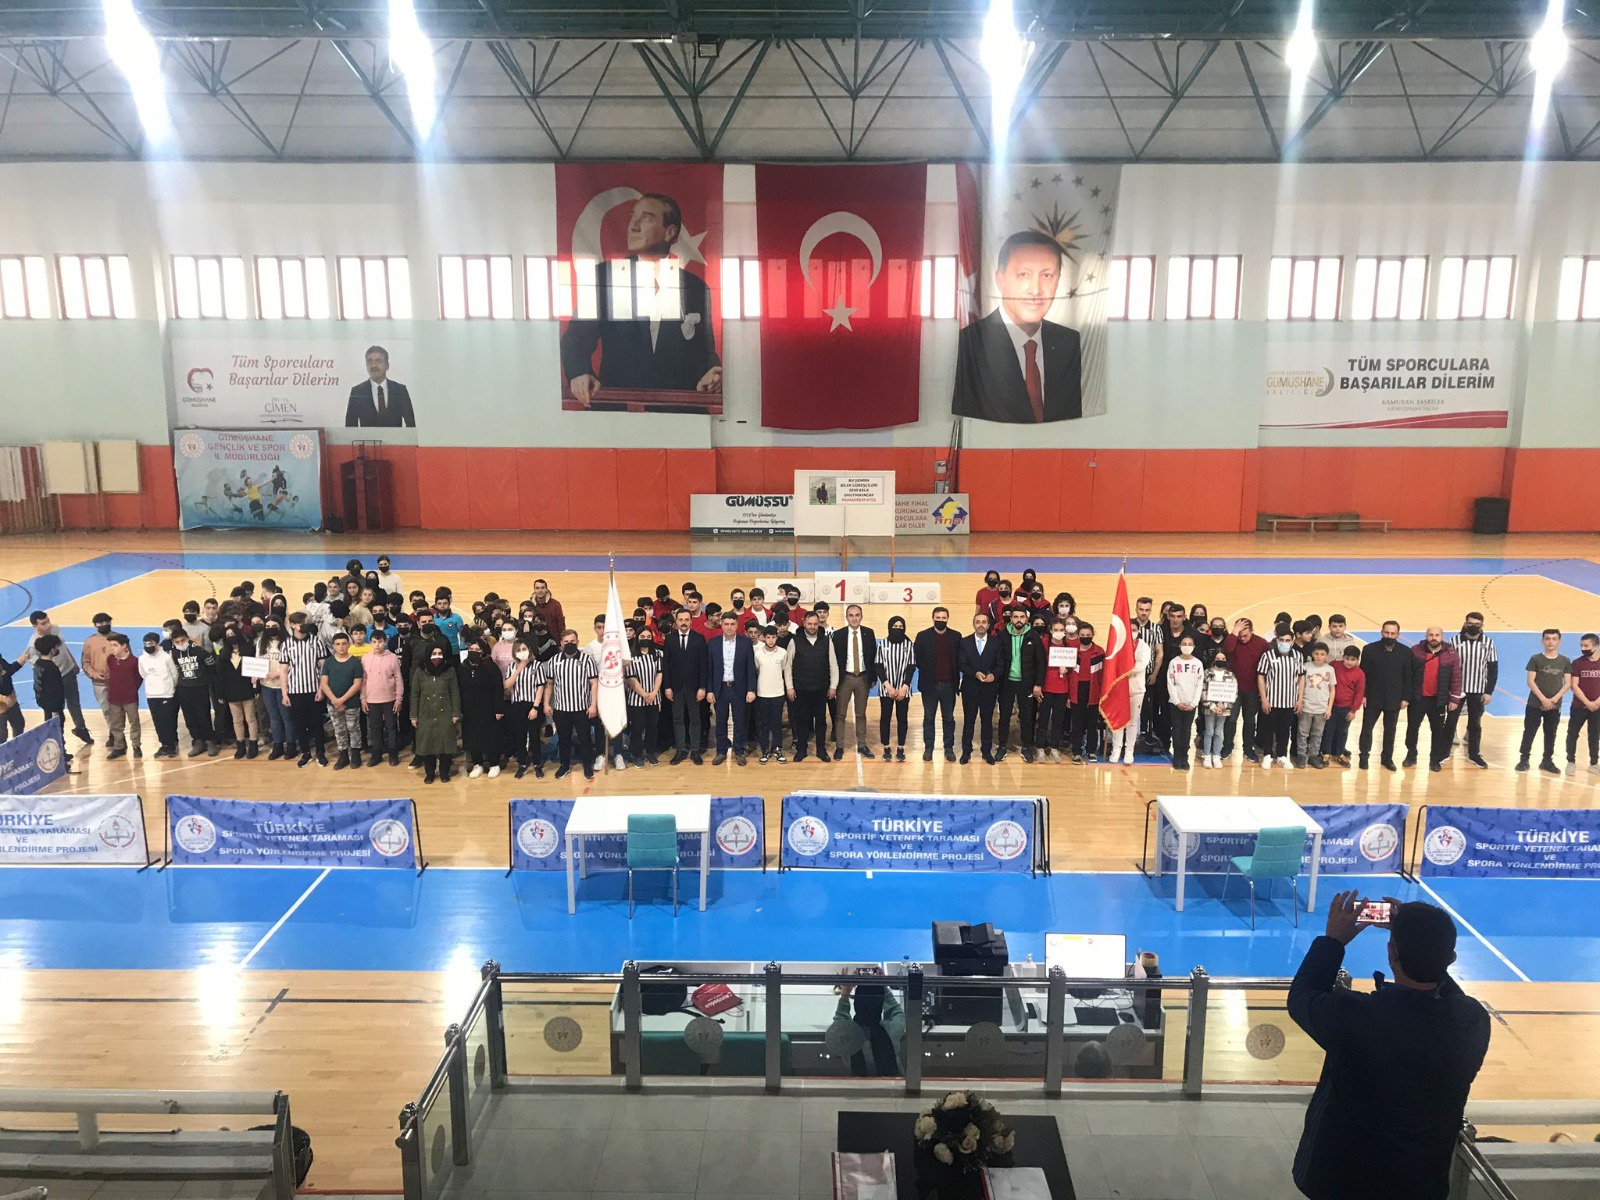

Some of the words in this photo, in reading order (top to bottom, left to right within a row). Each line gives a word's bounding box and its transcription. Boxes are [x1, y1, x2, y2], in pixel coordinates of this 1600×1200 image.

[231, 354, 259, 369] Tüm
[263, 354, 335, 372] Sporculara
[1348, 355, 1384, 372] TÜM
[1386, 357, 1490, 373] SPORCULARA
[229, 372, 289, 389] Başarılar
[292, 372, 340, 387] Dilerim
[1339, 376, 1427, 393] BAŞARILAR
[1431, 373, 1496, 390] DİLERİM
[248, 443, 260, 451] VE
[262, 444, 286, 452] SPOR
[725, 495, 789, 508] GÜMÜŞSU
[834, 579, 847, 602] 1
[902, 587, 913, 603] 3
[253, 820, 327, 834] TÜRKİYE
[871, 817, 943, 833] TÜRKİYE
[311, 834, 364, 842] TARAMASI
[834, 831, 877, 841] SPORTİF
[879, 834, 924, 842] YETENEK
[927, 835, 980, 843] TARAMASI
[1515, 828, 1590, 843] TÜRKİYE
[56, 845, 99, 853] PROJESİ
[219, 847, 253, 855] SPORA
[329, 847, 371, 857] PROJESİ
[1475, 842, 1521, 851] SPORTİF
[1523, 844, 1570, 853] YETENEK
[829, 851, 863, 859] SPORA
[866, 849, 939, 860] YÖNLENDİRME
[941, 851, 984, 861] PROJESİ
[1467, 859, 1503, 868] SPORA
[1506, 860, 1582, 871] YÖNLENDİRME
